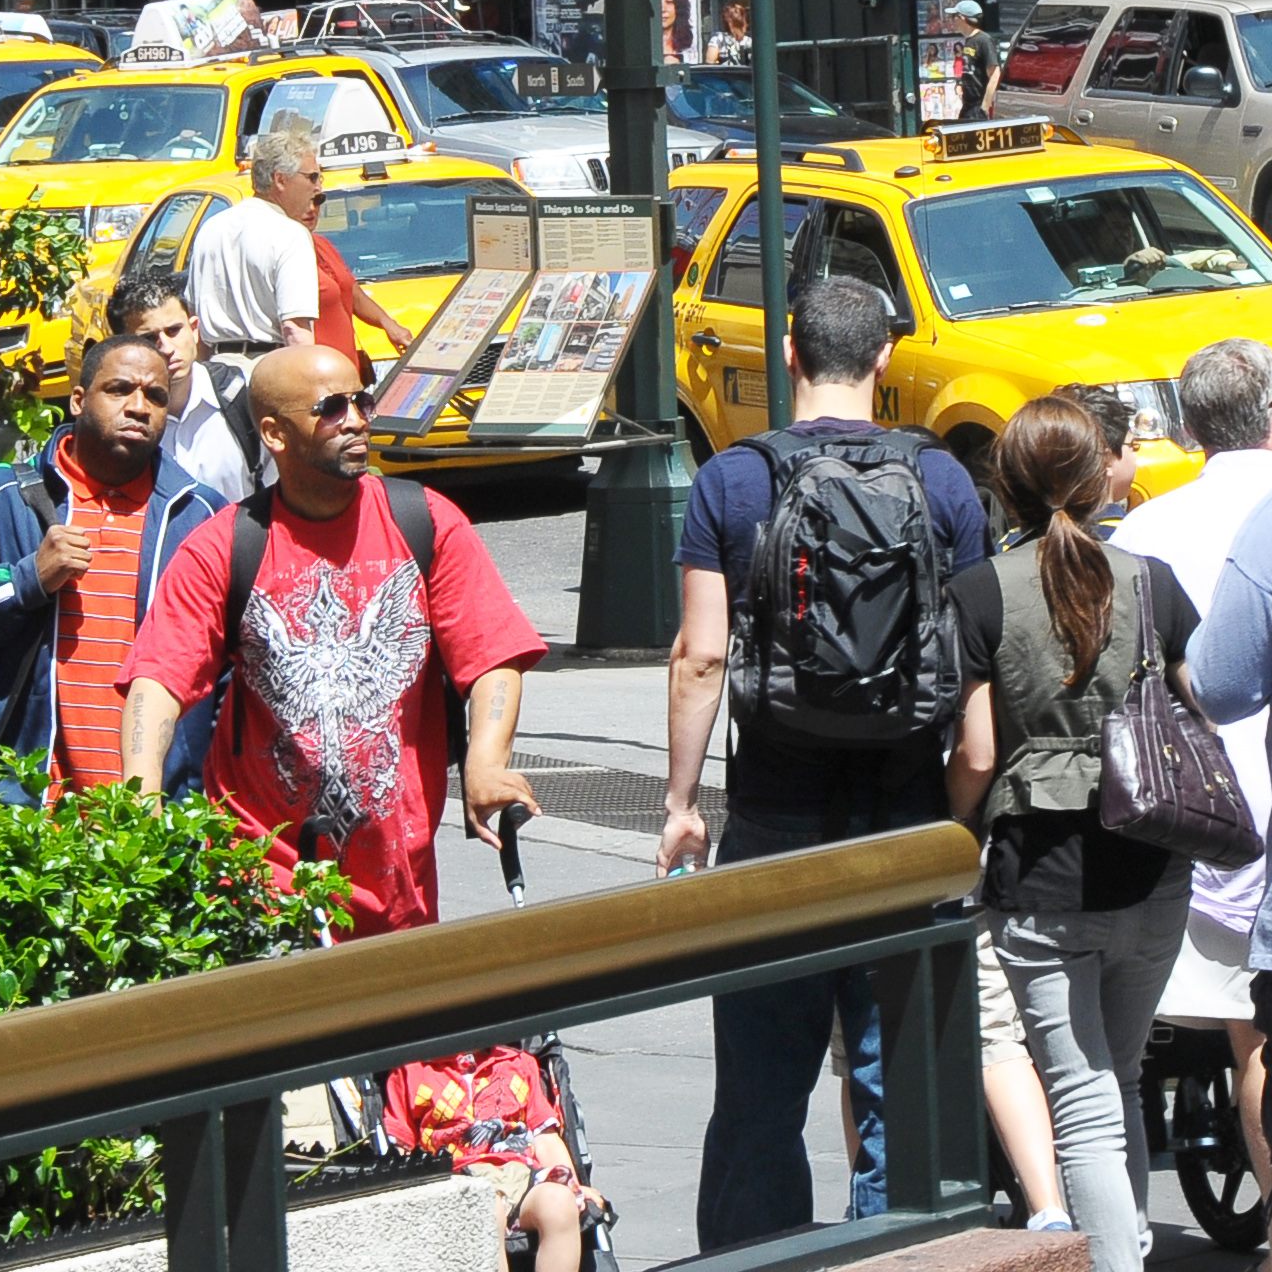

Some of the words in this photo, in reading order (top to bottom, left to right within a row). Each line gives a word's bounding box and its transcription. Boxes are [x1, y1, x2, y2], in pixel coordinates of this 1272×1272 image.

[566, 74, 585, 87] South
[341, 134, 378, 154] 1J96
[975, 127, 1014, 152] 3F11
[543, 204, 573, 216] Things
[573, 205, 584, 214] to
[585, 204, 602, 214] See
[603, 203, 620, 214] and
[621, 204, 635, 214] Do
